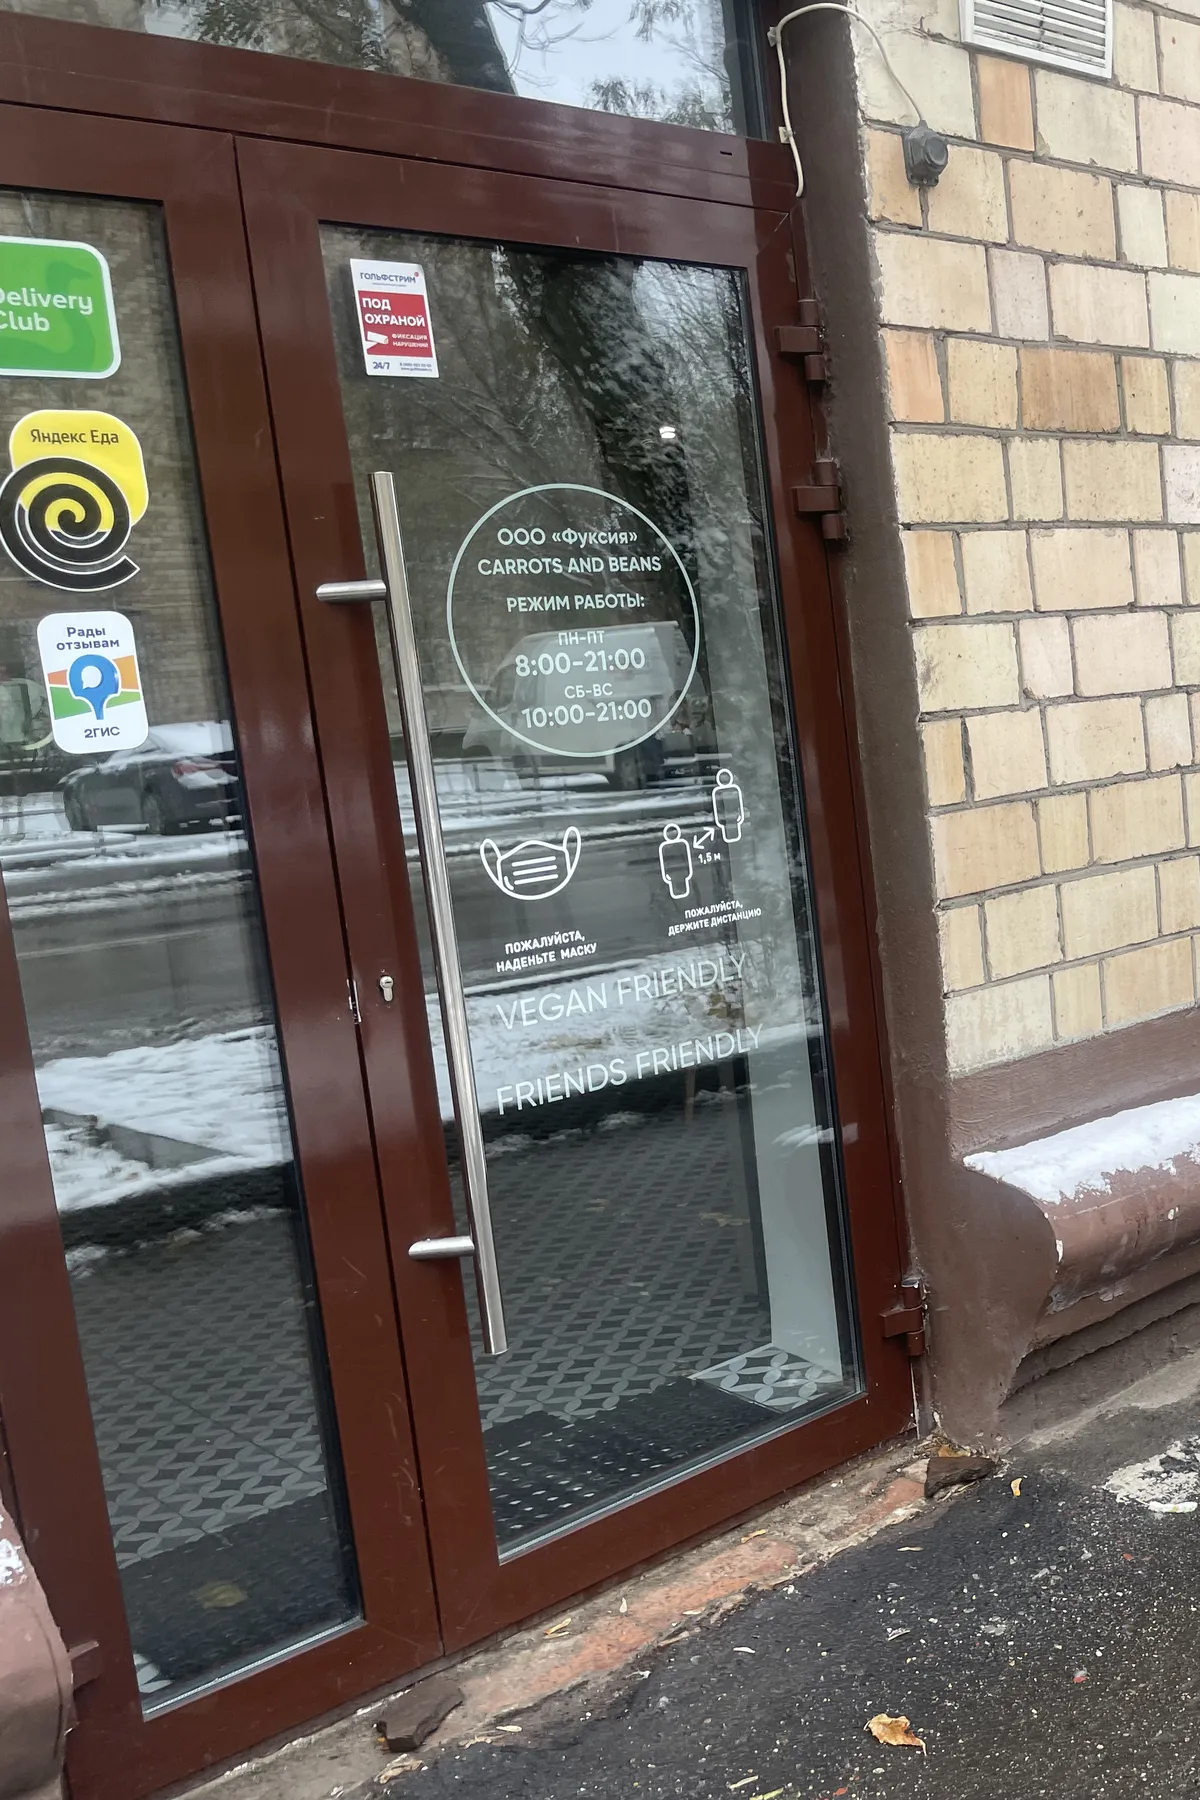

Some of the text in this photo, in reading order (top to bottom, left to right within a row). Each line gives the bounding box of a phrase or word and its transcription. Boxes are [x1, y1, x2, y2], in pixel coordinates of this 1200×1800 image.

[360, 272, 416, 283] ГОЛЬФСТРИМ
[361, 297, 391, 311] ПОД
[364, 313, 426, 327] ОХРАНОЙ
[372, 361, 390, 370] 24/7
[30, 428, 119, 445] Яндекс Еда
[497, 527, 638, 548] ООО «Фуксия»
[477, 556, 662, 576] CARROTS AND BEANS
[506, 593, 645, 613] РЕЖИМ РАБОТЫ:
[66, 626, 106, 638] Рады
[558, 630, 605, 646] ПН-ПТ
[56, 639, 120, 651] отзывам
[515, 647, 646, 677] 8:00-21:00
[564, 682, 614, 699] СБ-ВС
[521, 698, 652, 729] 10:00-21:00
[84, 726, 120, 738] 2ГИС
[697, 852, 712, 864] 1,5
[684, 900, 744, 919] ПОЖАЛУЙСТА,
[668, 907, 762, 937] ДЕРЖИТЕ ДИСТАНЦИЮ
[504, 930, 586, 955] ПОЖАЛУЙСТА,
[496, 942, 597, 973] НАДЕНЬТЕ МАСКУ
[495, 952, 748, 1031] VEGAN FRIENDLY
[495, 1023, 764, 1116] FRIENDS FRIENDLY
